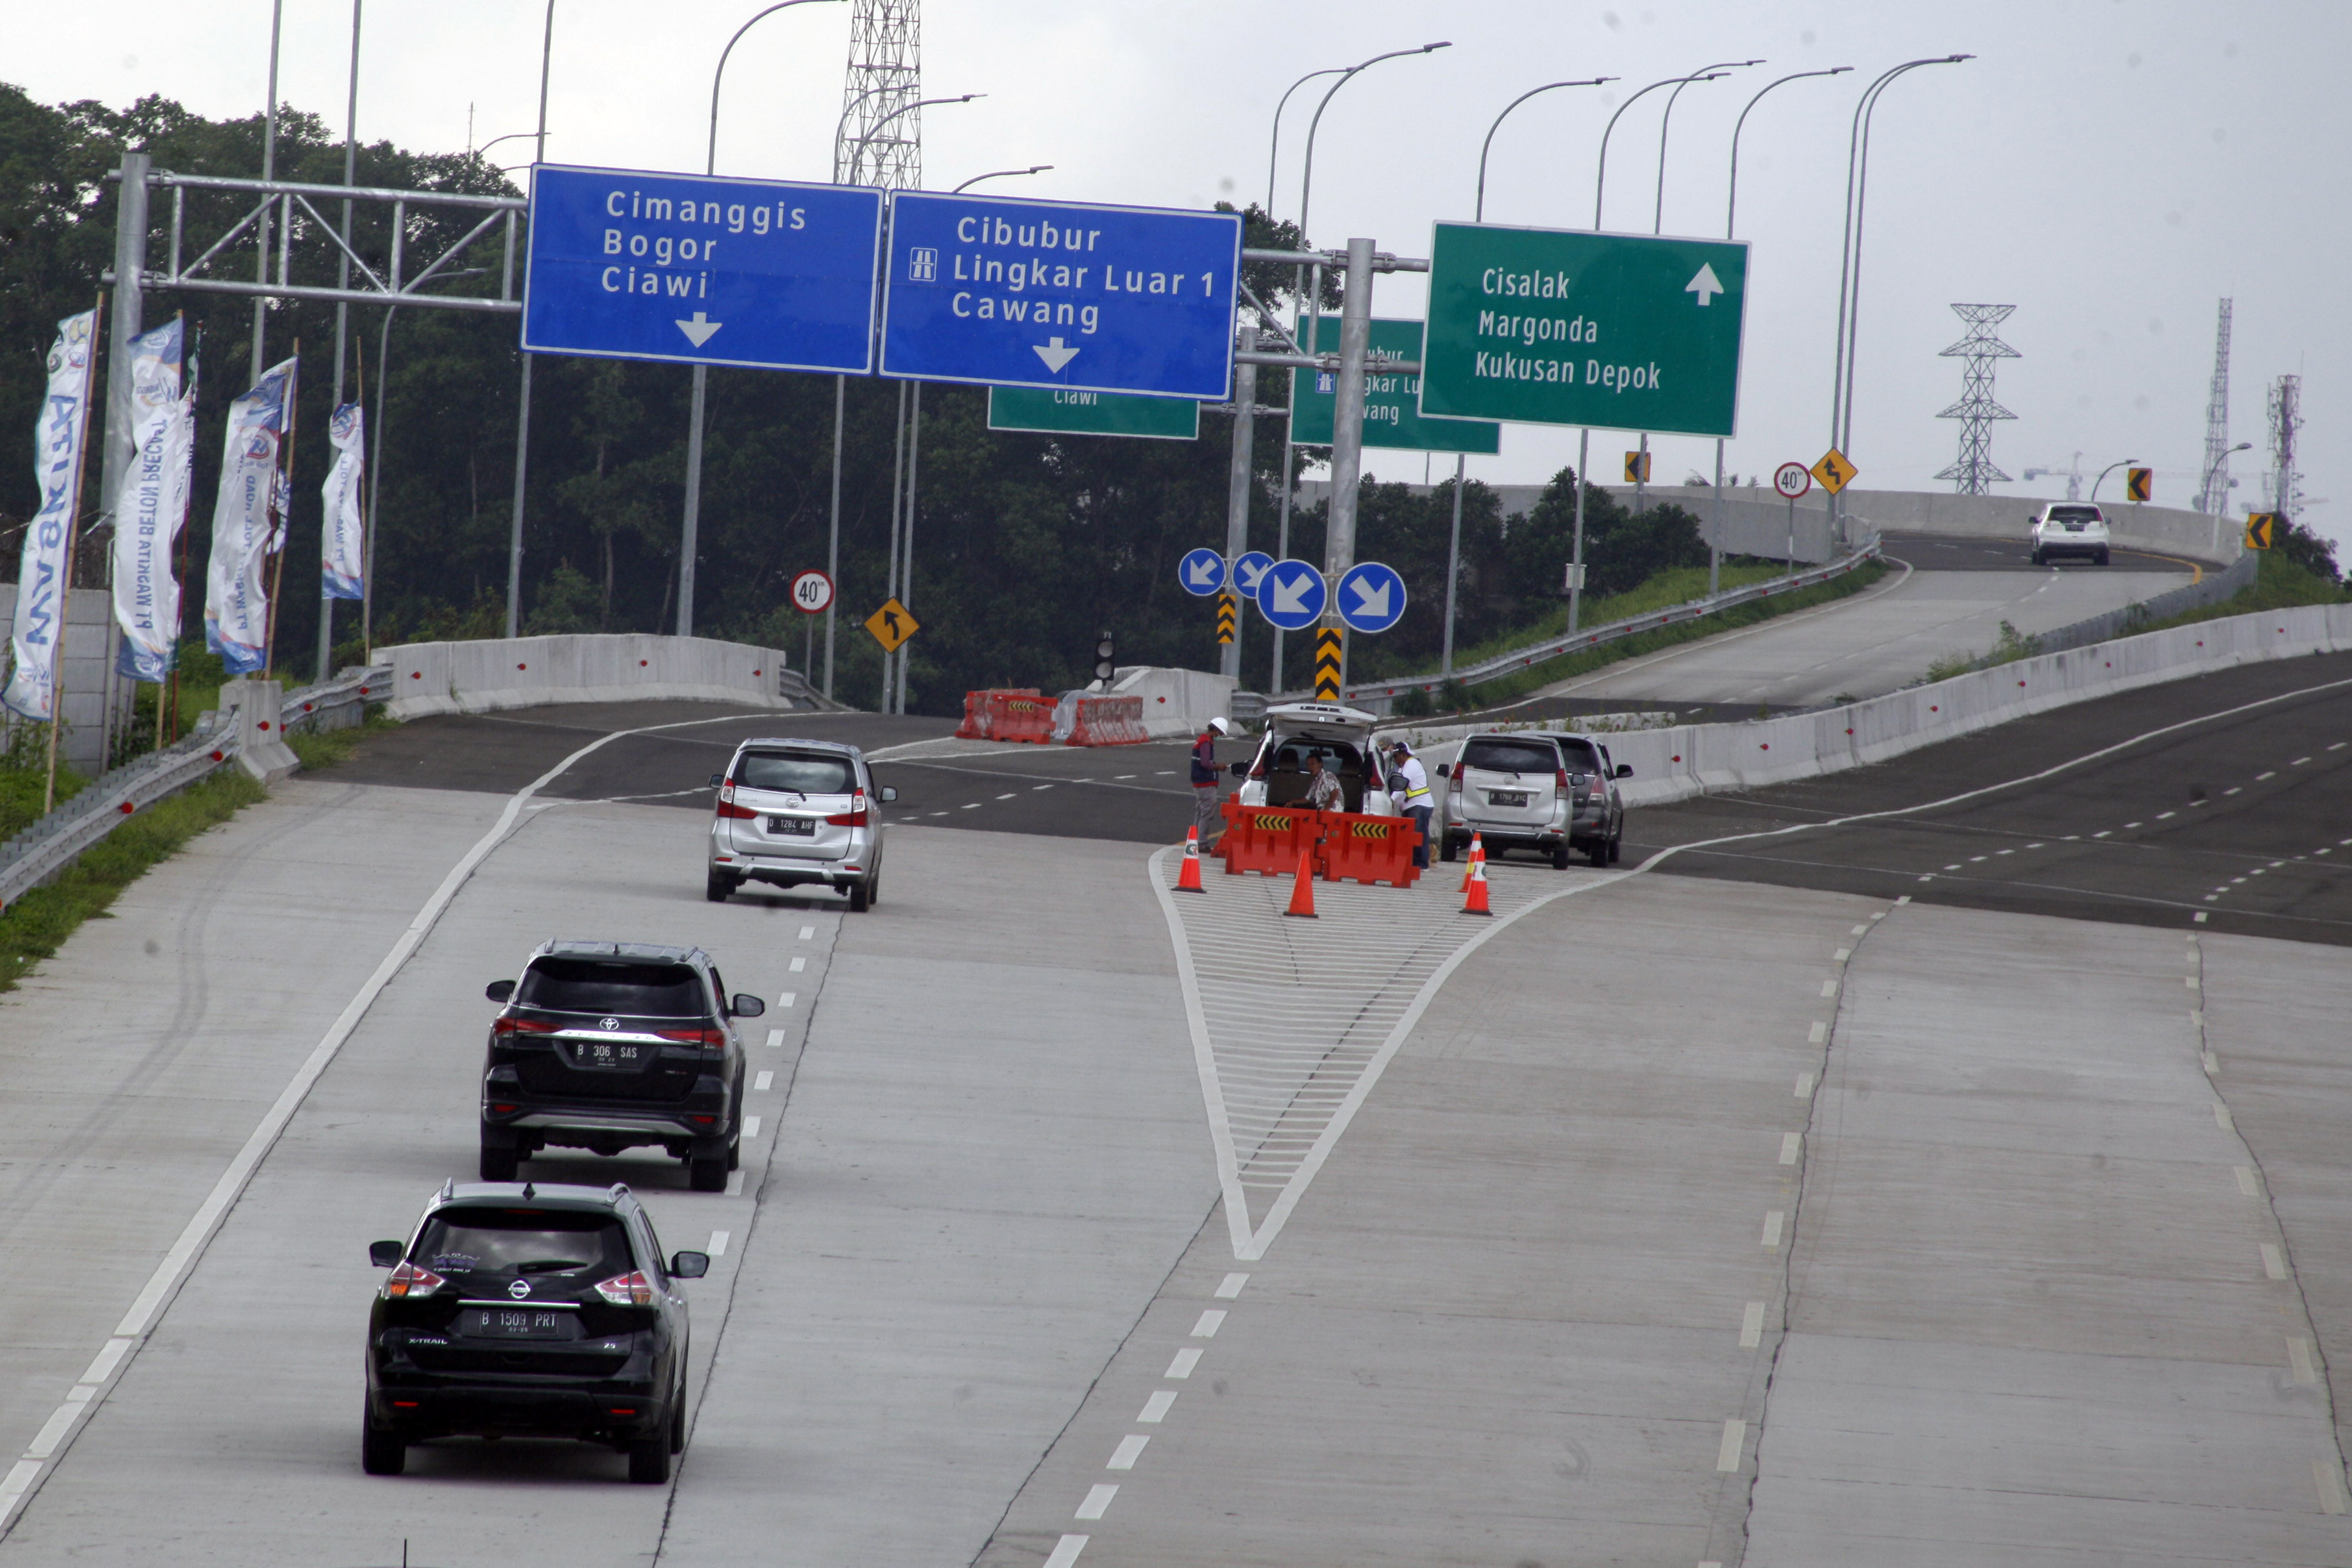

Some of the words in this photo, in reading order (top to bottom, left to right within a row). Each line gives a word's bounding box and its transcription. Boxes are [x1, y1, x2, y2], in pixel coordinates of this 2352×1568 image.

[607, 191, 806, 234] Cimanggis
[604, 229, 716, 265] Bogor
[958, 217, 1100, 250] Cibubur
[602, 266, 707, 298] Ciawi
[954, 254, 1088, 292] Lingkar
[1105, 265, 1184, 295] Luar
[1201, 272, 1213, 297] 1
[1483, 267, 1570, 299] Cisalak
[953, 292, 1098, 335] Cawang
[1479, 310, 1598, 345] Margonda
[1475, 352, 1574, 383] Kukusan
[1586, 359, 1661, 393] Depok
[1782, 472, 1797, 489] 40
[799, 581, 817, 602] 40
[781, 819, 797, 828] 1284
[801, 821, 814, 830] AHF
[578, 1044, 584, 1055] B
[593, 1045, 610, 1057] 306
[620, 1047, 637, 1058] SAS
[482, 1312, 489, 1325] B
[500, 1313, 526, 1326] 1509
[535, 1314, 556, 1327] PRT
